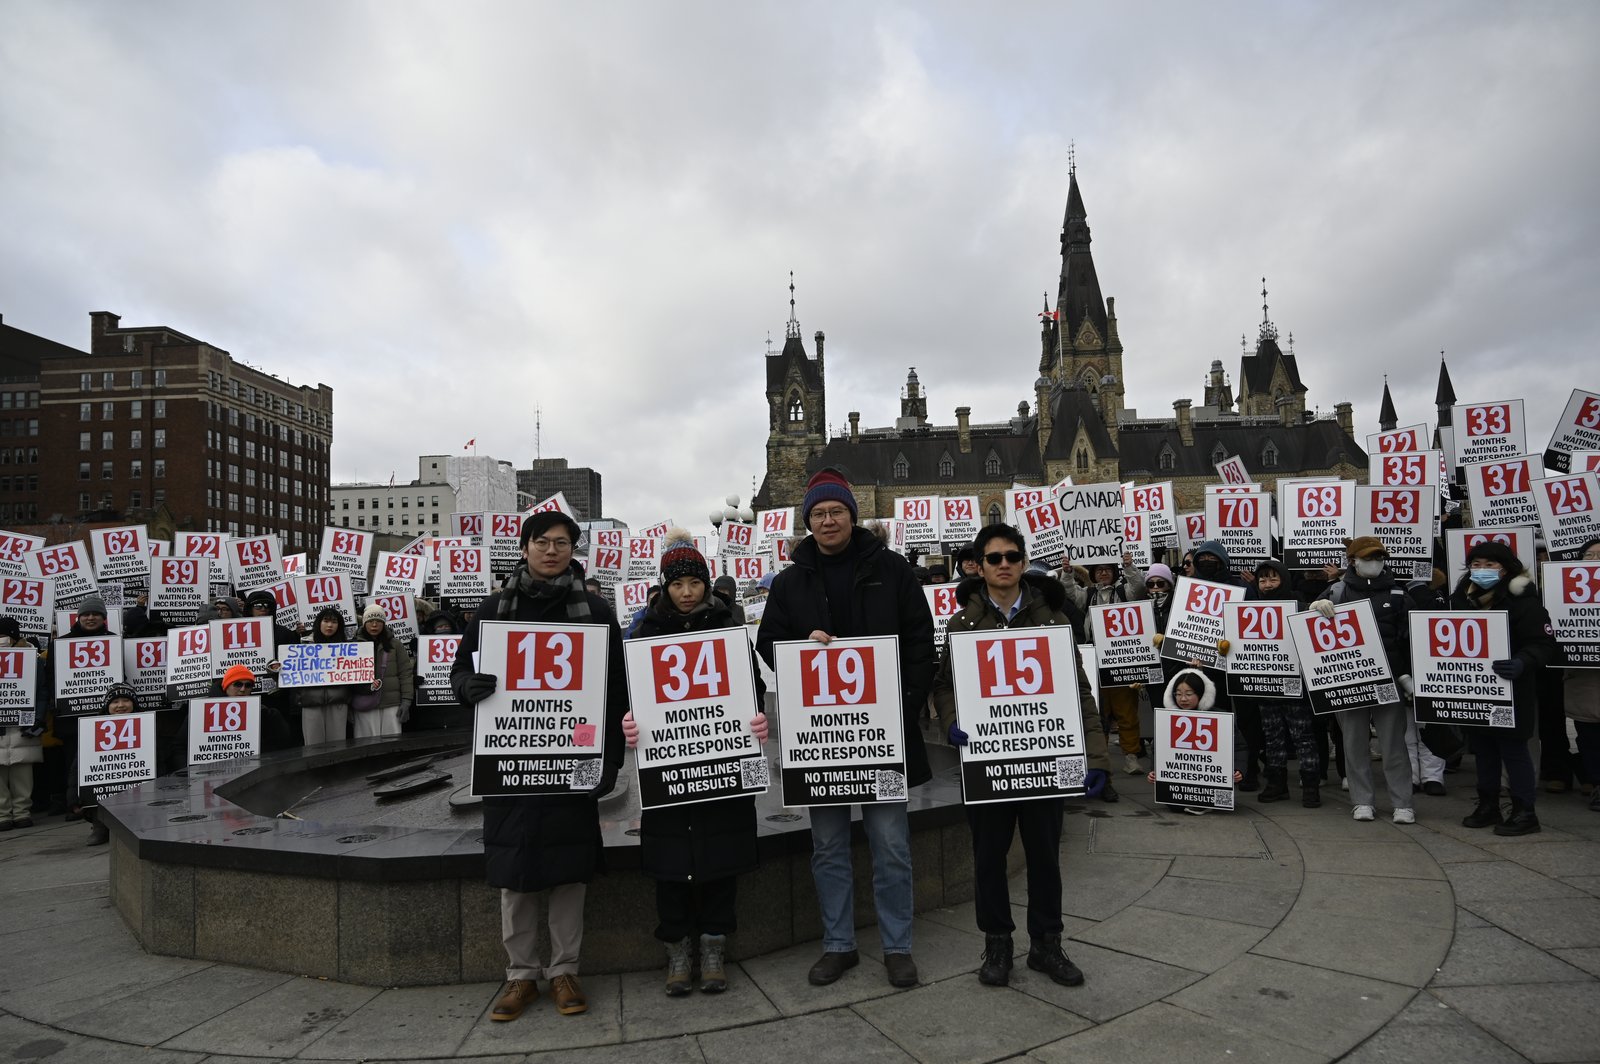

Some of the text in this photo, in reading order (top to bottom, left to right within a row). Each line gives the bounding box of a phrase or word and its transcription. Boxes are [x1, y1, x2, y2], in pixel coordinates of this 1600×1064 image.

[1471, 406, 1506, 435] 33
[1464, 444, 1516, 455] WAITING FOR
[1471, 437, 1506, 446] MONTHS
[1387, 457, 1422, 485] 35
[1487, 463, 1523, 495] 37
[1060, 490, 1122, 512] CANADA
[1136, 488, 1160, 511] 36
[1302, 487, 1336, 516] 68
[1376, 491, 1414, 522] 53
[1490, 496, 1528, 508] MONTHS
[1551, 480, 1587, 514] 25
[906, 500, 928, 520] 30
[948, 500, 971, 520] 32
[1030, 504, 1056, 532] 13
[1224, 499, 1254, 526] 70
[496, 516, 518, 536] 25
[767, 512, 783, 531] 27
[1062, 518, 1122, 538] WHAT ARE
[1302, 520, 1336, 528] MONTHS
[1558, 515, 1591, 526] MONTHS
[107, 530, 136, 553] 62
[336, 531, 357, 554] 31
[602, 531, 618, 546] 39
[730, 525, 747, 544] 16
[0, 536, 26, 561] 43
[190, 536, 216, 558] 22
[242, 541, 268, 564] 43
[632, 539, 652, 558] 34
[1064, 536, 1124, 560] YOU DOING?
[44, 548, 74, 574] 55
[394, 556, 416, 578] 39
[454, 550, 478, 572] 39
[600, 551, 618, 568] 72
[738, 559, 758, 578] 16
[166, 560, 193, 584] 39
[6, 581, 38, 606] 25
[310, 580, 338, 602] 40
[626, 584, 646, 605] 30
[1190, 586, 1223, 616] 30
[384, 598, 402, 621] 39
[1108, 607, 1138, 637] 30
[1187, 614, 1220, 626] MONTHS
[1242, 607, 1279, 639] 20
[228, 623, 255, 649] 11
[1314, 612, 1356, 650] 65
[1434, 618, 1482, 657] 90
[183, 630, 207, 656] 19
[288, 644, 358, 658] STOP THE
[432, 640, 456, 662] 39
[1110, 638, 1141, 648] MONTHS
[1243, 643, 1279, 652] MONTHS
[74, 640, 105, 667] 53
[141, 642, 166, 666] 81
[516, 632, 572, 690] 13
[1235, 652, 1289, 662] WAITING FOR
[1321, 649, 1362, 664] MONTHS
[327, 670, 374, 682] TOGETHER
[660, 640, 722, 700] 34
[811, 648, 865, 704] 19
[986, 638, 1043, 696] 15
[1231, 662, 1294, 672] IRCC RESPONSE
[1314, 658, 1376, 676] WAITING FOR
[1436, 662, 1484, 672] MONTHS
[1254, 684, 1284, 692] RESULTS
[1426, 672, 1498, 684] WAITING FOR
[1420, 684, 1505, 696] IRCC RESPONSE
[512, 699, 572, 712] MONTHS
[665, 704, 724, 724] MONTHS
[989, 702, 1048, 718] MONTHS
[1432, 700, 1494, 711] NO TIMELINES
[1436, 710, 1490, 720] NO RESULTS
[210, 702, 240, 732] 18
[494, 717, 556, 730] WAITING
[810, 712, 870, 728] MONTHS
[976, 718, 1065, 736] WAITING FOR
[100, 719, 136, 750] 34
[207, 734, 242, 744] MONTHS
[484, 734, 594, 748] IRCC RESPON
[652, 720, 742, 743] WAITING FOR
[796, 728, 886, 744] WAITING FOR
[1174, 716, 1212, 750] 25
[198, 742, 250, 752] WAITING FOR
[645, 735, 752, 762] IRCC RESPONSE
[789, 744, 896, 762] IRCC RESPONSE
[970, 734, 1075, 755] IRCC RESPONSE
[90, 760, 146, 773] WAITING FOR
[99, 752, 136, 762] MONTHS
[498, 760, 516, 772] NO
[1174, 753, 1212, 764] MONTHS
[84, 768, 150, 782] IRCC RESPONSE
[662, 762, 740, 782] NO TIMELINES
[804, 772, 821, 784] NO
[986, 766, 1002, 778] NO
[1160, 770, 1228, 784] IRCC RESPONSE
[1165, 762, 1222, 774] WAITING FOR
[502, 774, 572, 786] NO RESULTS
[668, 776, 737, 796] NO RESULTS
[810, 783, 878, 797] NO RESULTS
[992, 776, 1060, 791] NO RESULTS
[1169, 785, 1180, 793] NO
[1184, 794, 1215, 803] RESULTS
